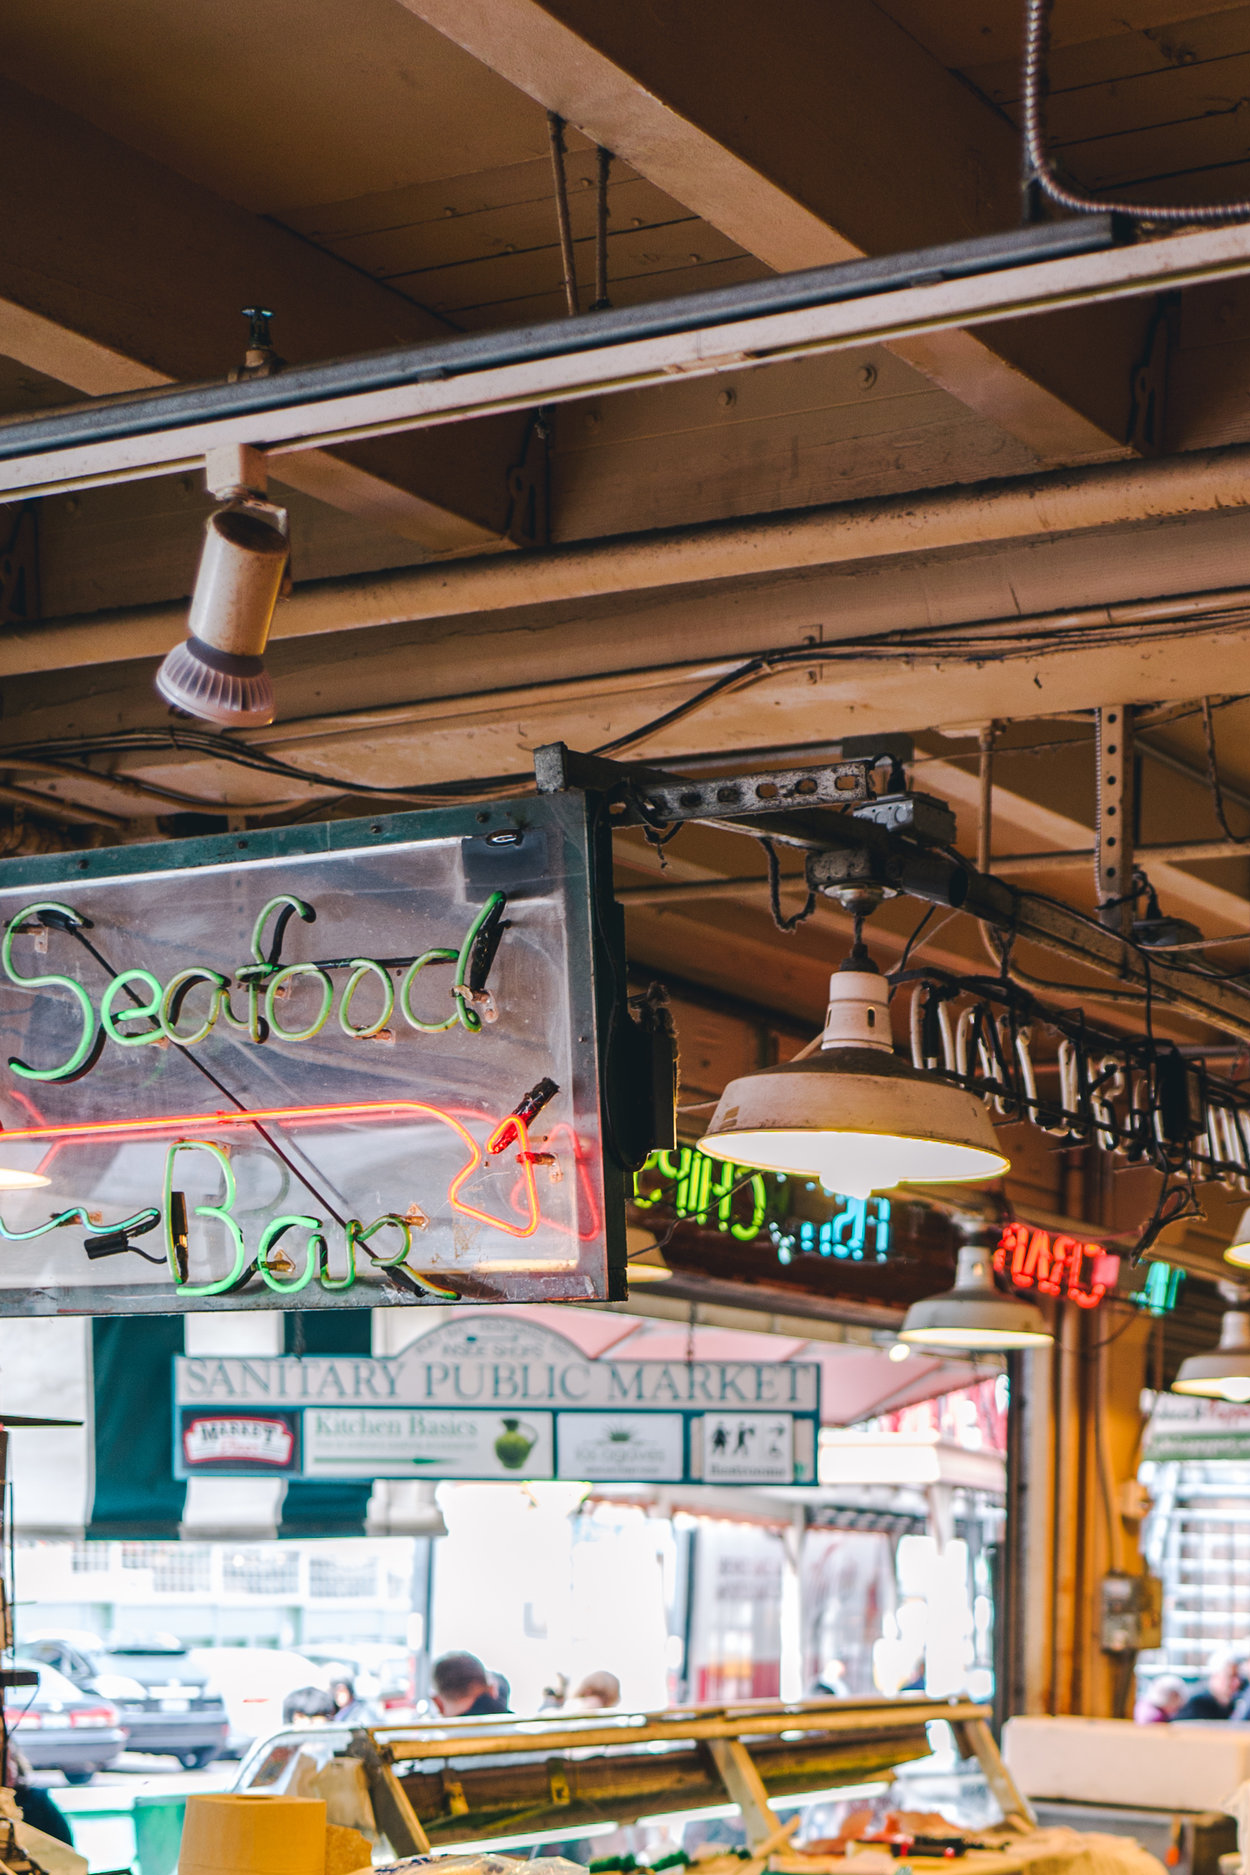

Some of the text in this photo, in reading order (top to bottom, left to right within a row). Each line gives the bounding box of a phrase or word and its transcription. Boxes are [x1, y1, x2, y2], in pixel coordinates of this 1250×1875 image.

[3, 891, 508, 1082] Seafood
[185, 1358, 810, 1402] SANITARY PUBLIC MARKET
[200, 1421, 277, 1442] MARKET
[314, 1412, 479, 1437] Kitchen Basics
